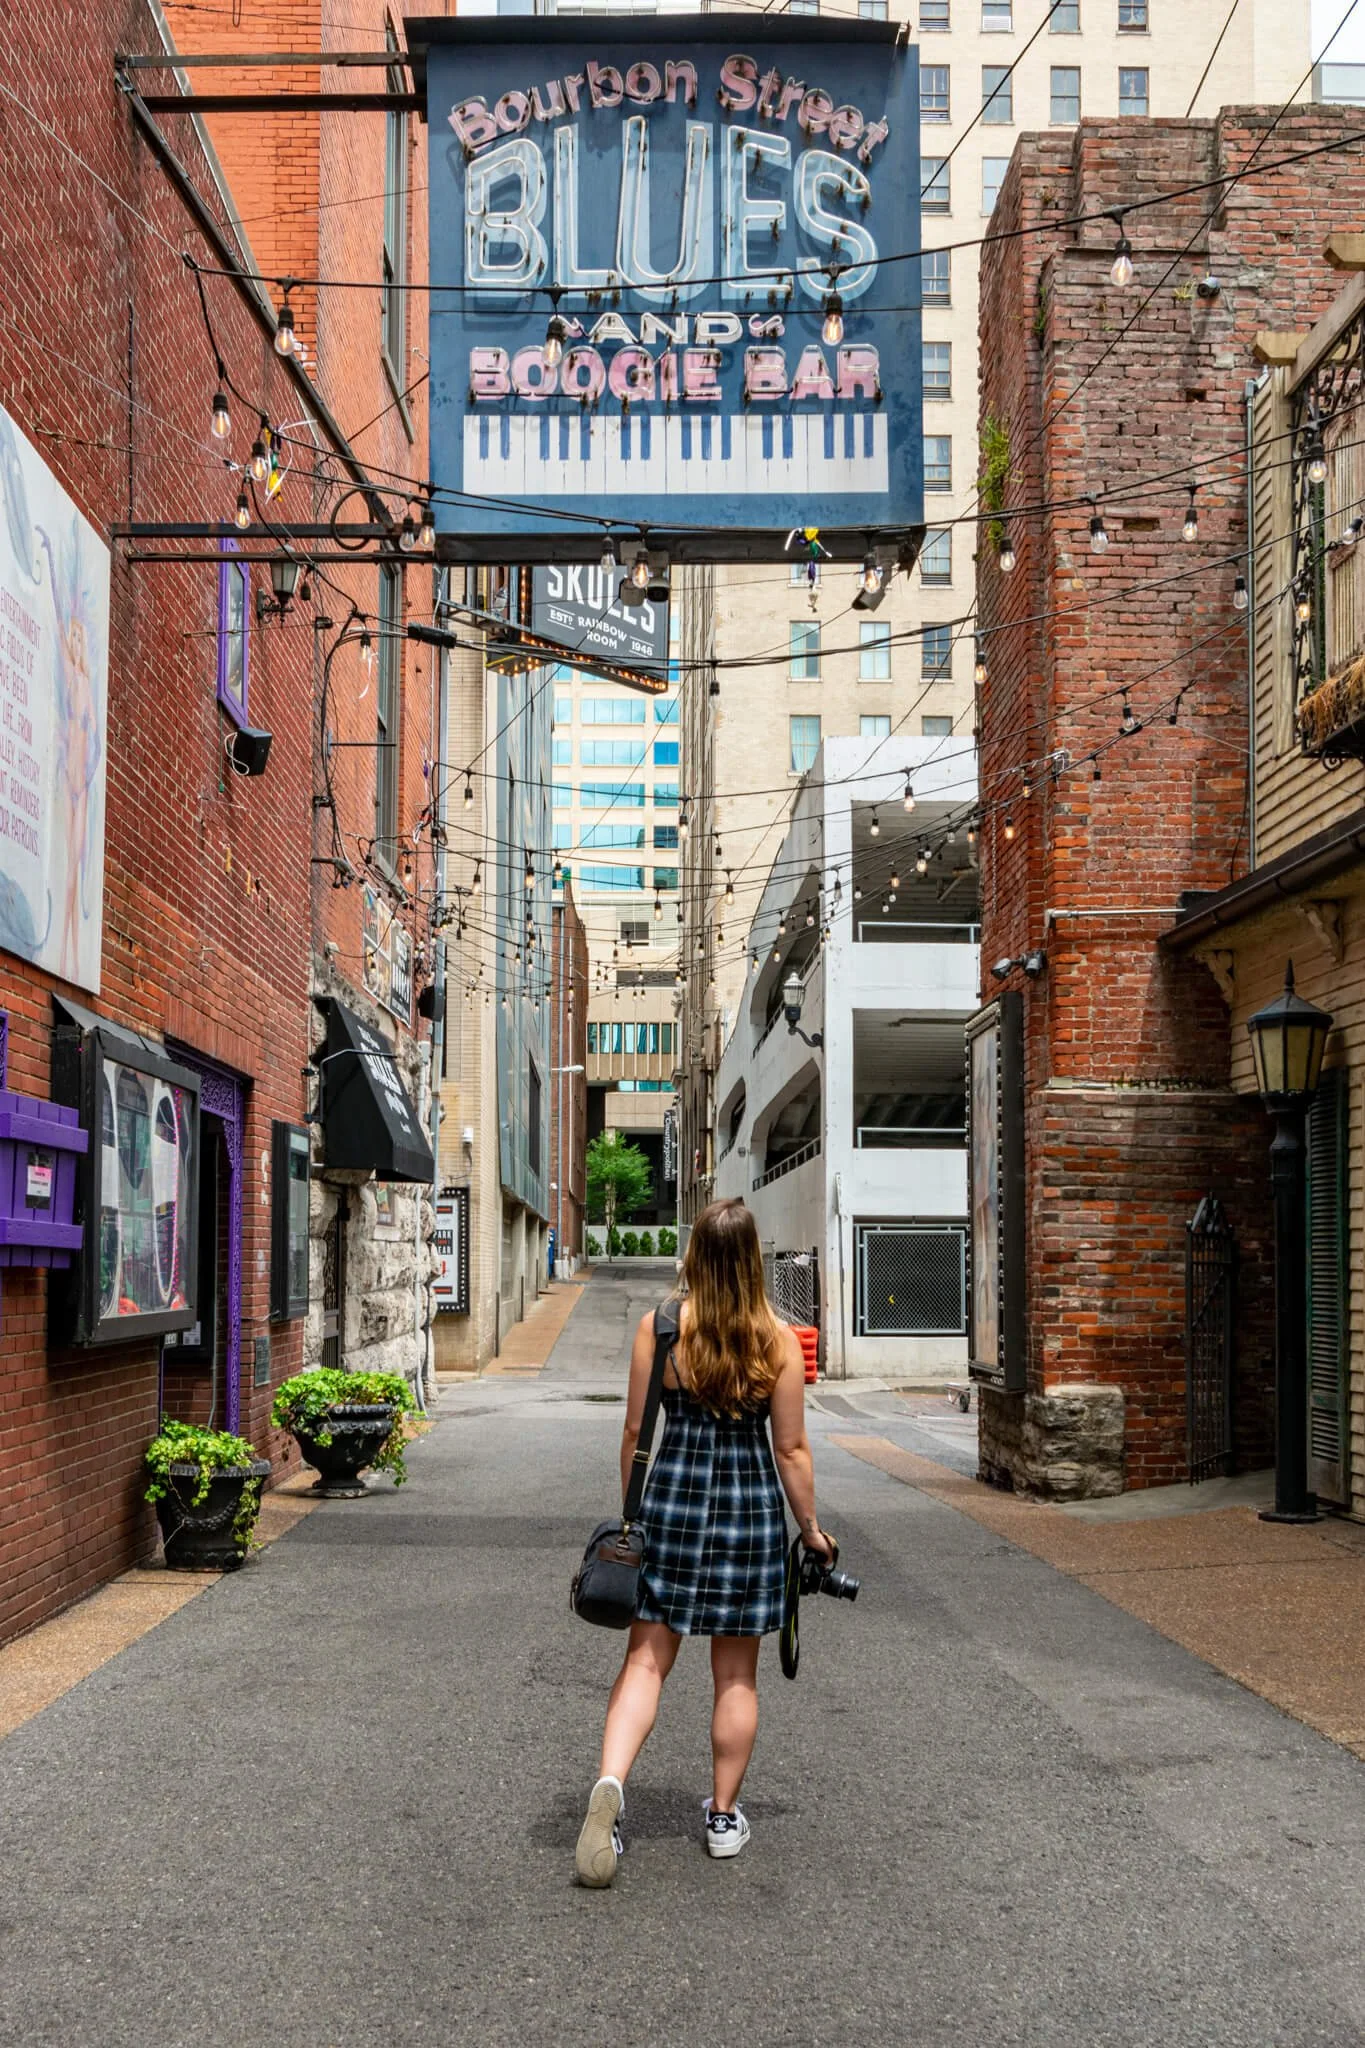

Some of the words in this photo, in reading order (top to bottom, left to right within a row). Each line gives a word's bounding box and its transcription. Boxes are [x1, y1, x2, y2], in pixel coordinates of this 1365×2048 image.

[447, 59, 698, 154] Bourbon
[718, 54, 890, 163] Street
[464, 115, 879, 304] BLUES
[587, 311, 743, 346] AND
[469, 345, 723, 402] BOOGIE
[744, 345, 882, 402] BAR
[577, 616, 628, 643] RAINBOW
[586, 630, 618, 650] ROOM
[631, 640, 653, 657] 1948
